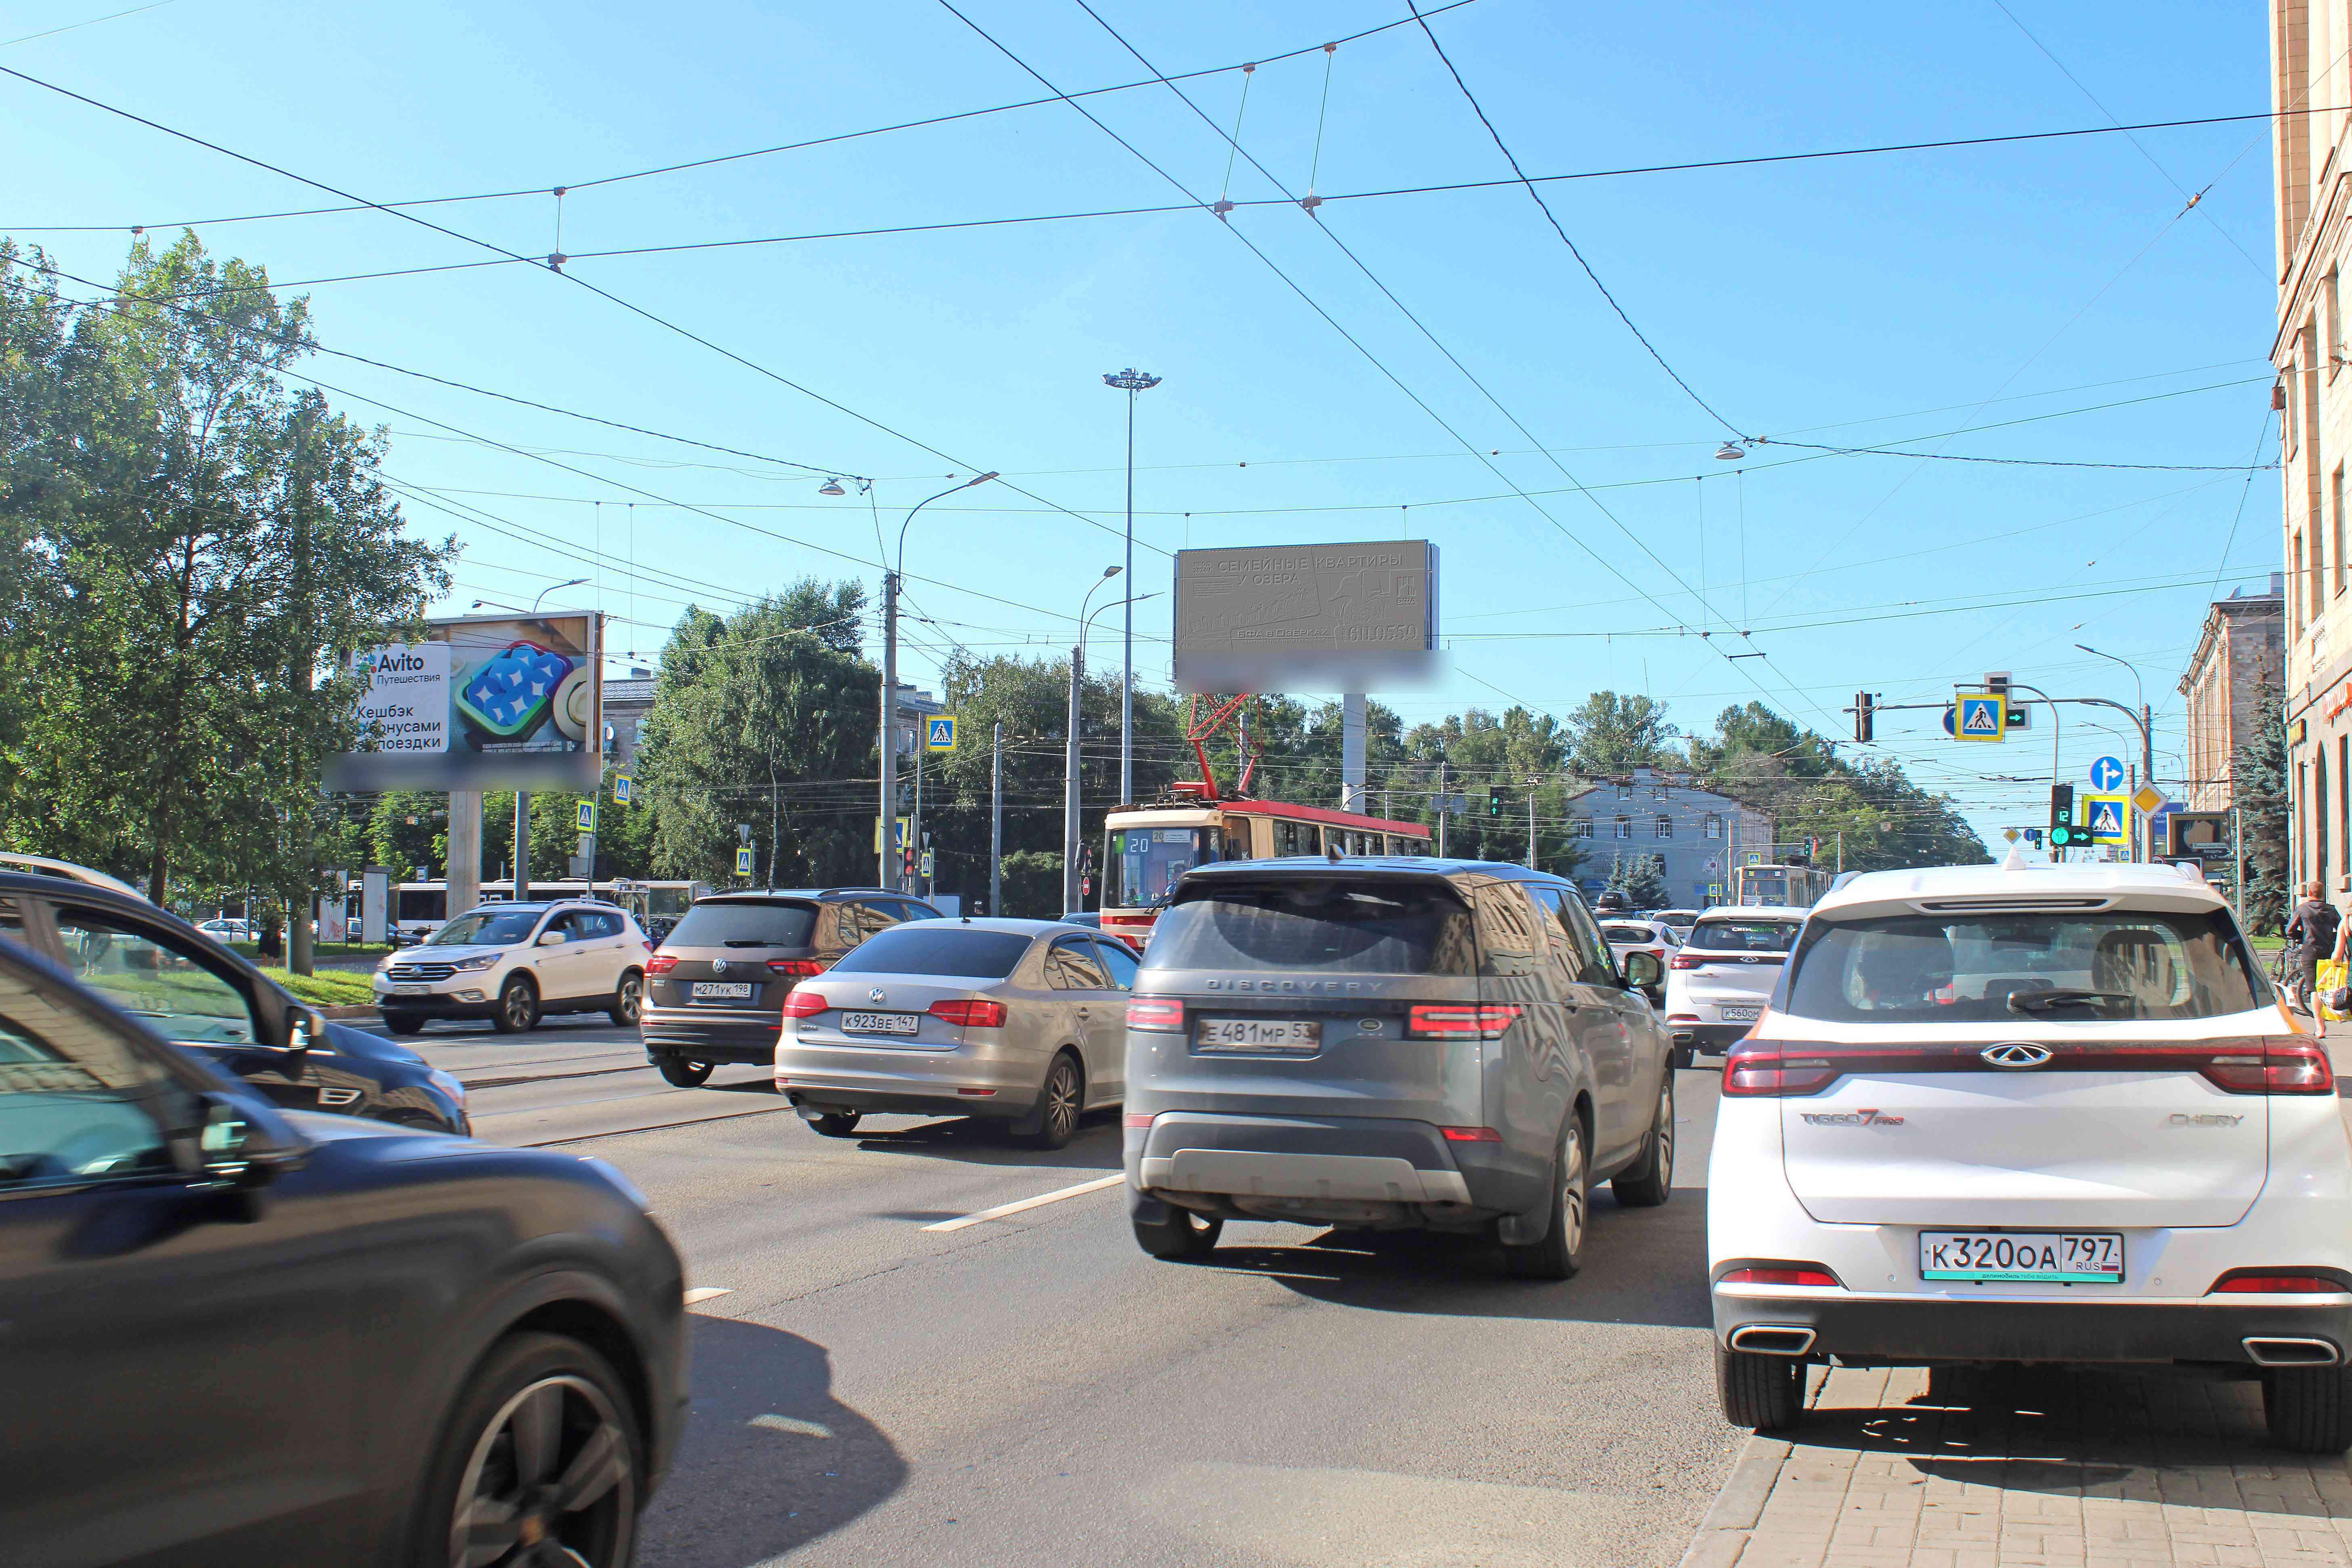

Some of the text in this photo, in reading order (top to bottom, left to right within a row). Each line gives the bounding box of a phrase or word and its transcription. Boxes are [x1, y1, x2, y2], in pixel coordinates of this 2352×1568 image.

[1218, 554, 1402, 572] СЕМЕЙНЫЕ КВАРТИРЫ
[1238, 573, 1301, 586] У ОЗЕРА
[378, 653, 424, 672] Avito
[378, 674, 441, 686] Путешествия
[358, 705, 414, 718] Кешбэк
[372, 720, 441, 736] онусами
[567, 741, 575, 751] 12+
[1131, 838, 1148, 852] 20
[734, 984, 747, 993] 198
[1206, 979, 1383, 992] DISCOVERY
[846, 1014, 915, 1029] К923ВЕ 147
[1207, 1022, 1311, 1043] Е481МР 53
[2169, 1113, 2244, 1126] CHERY
[1932, 1237, 2113, 1269] К320ОА 797
[2076, 1262, 2100, 1270] RUS
